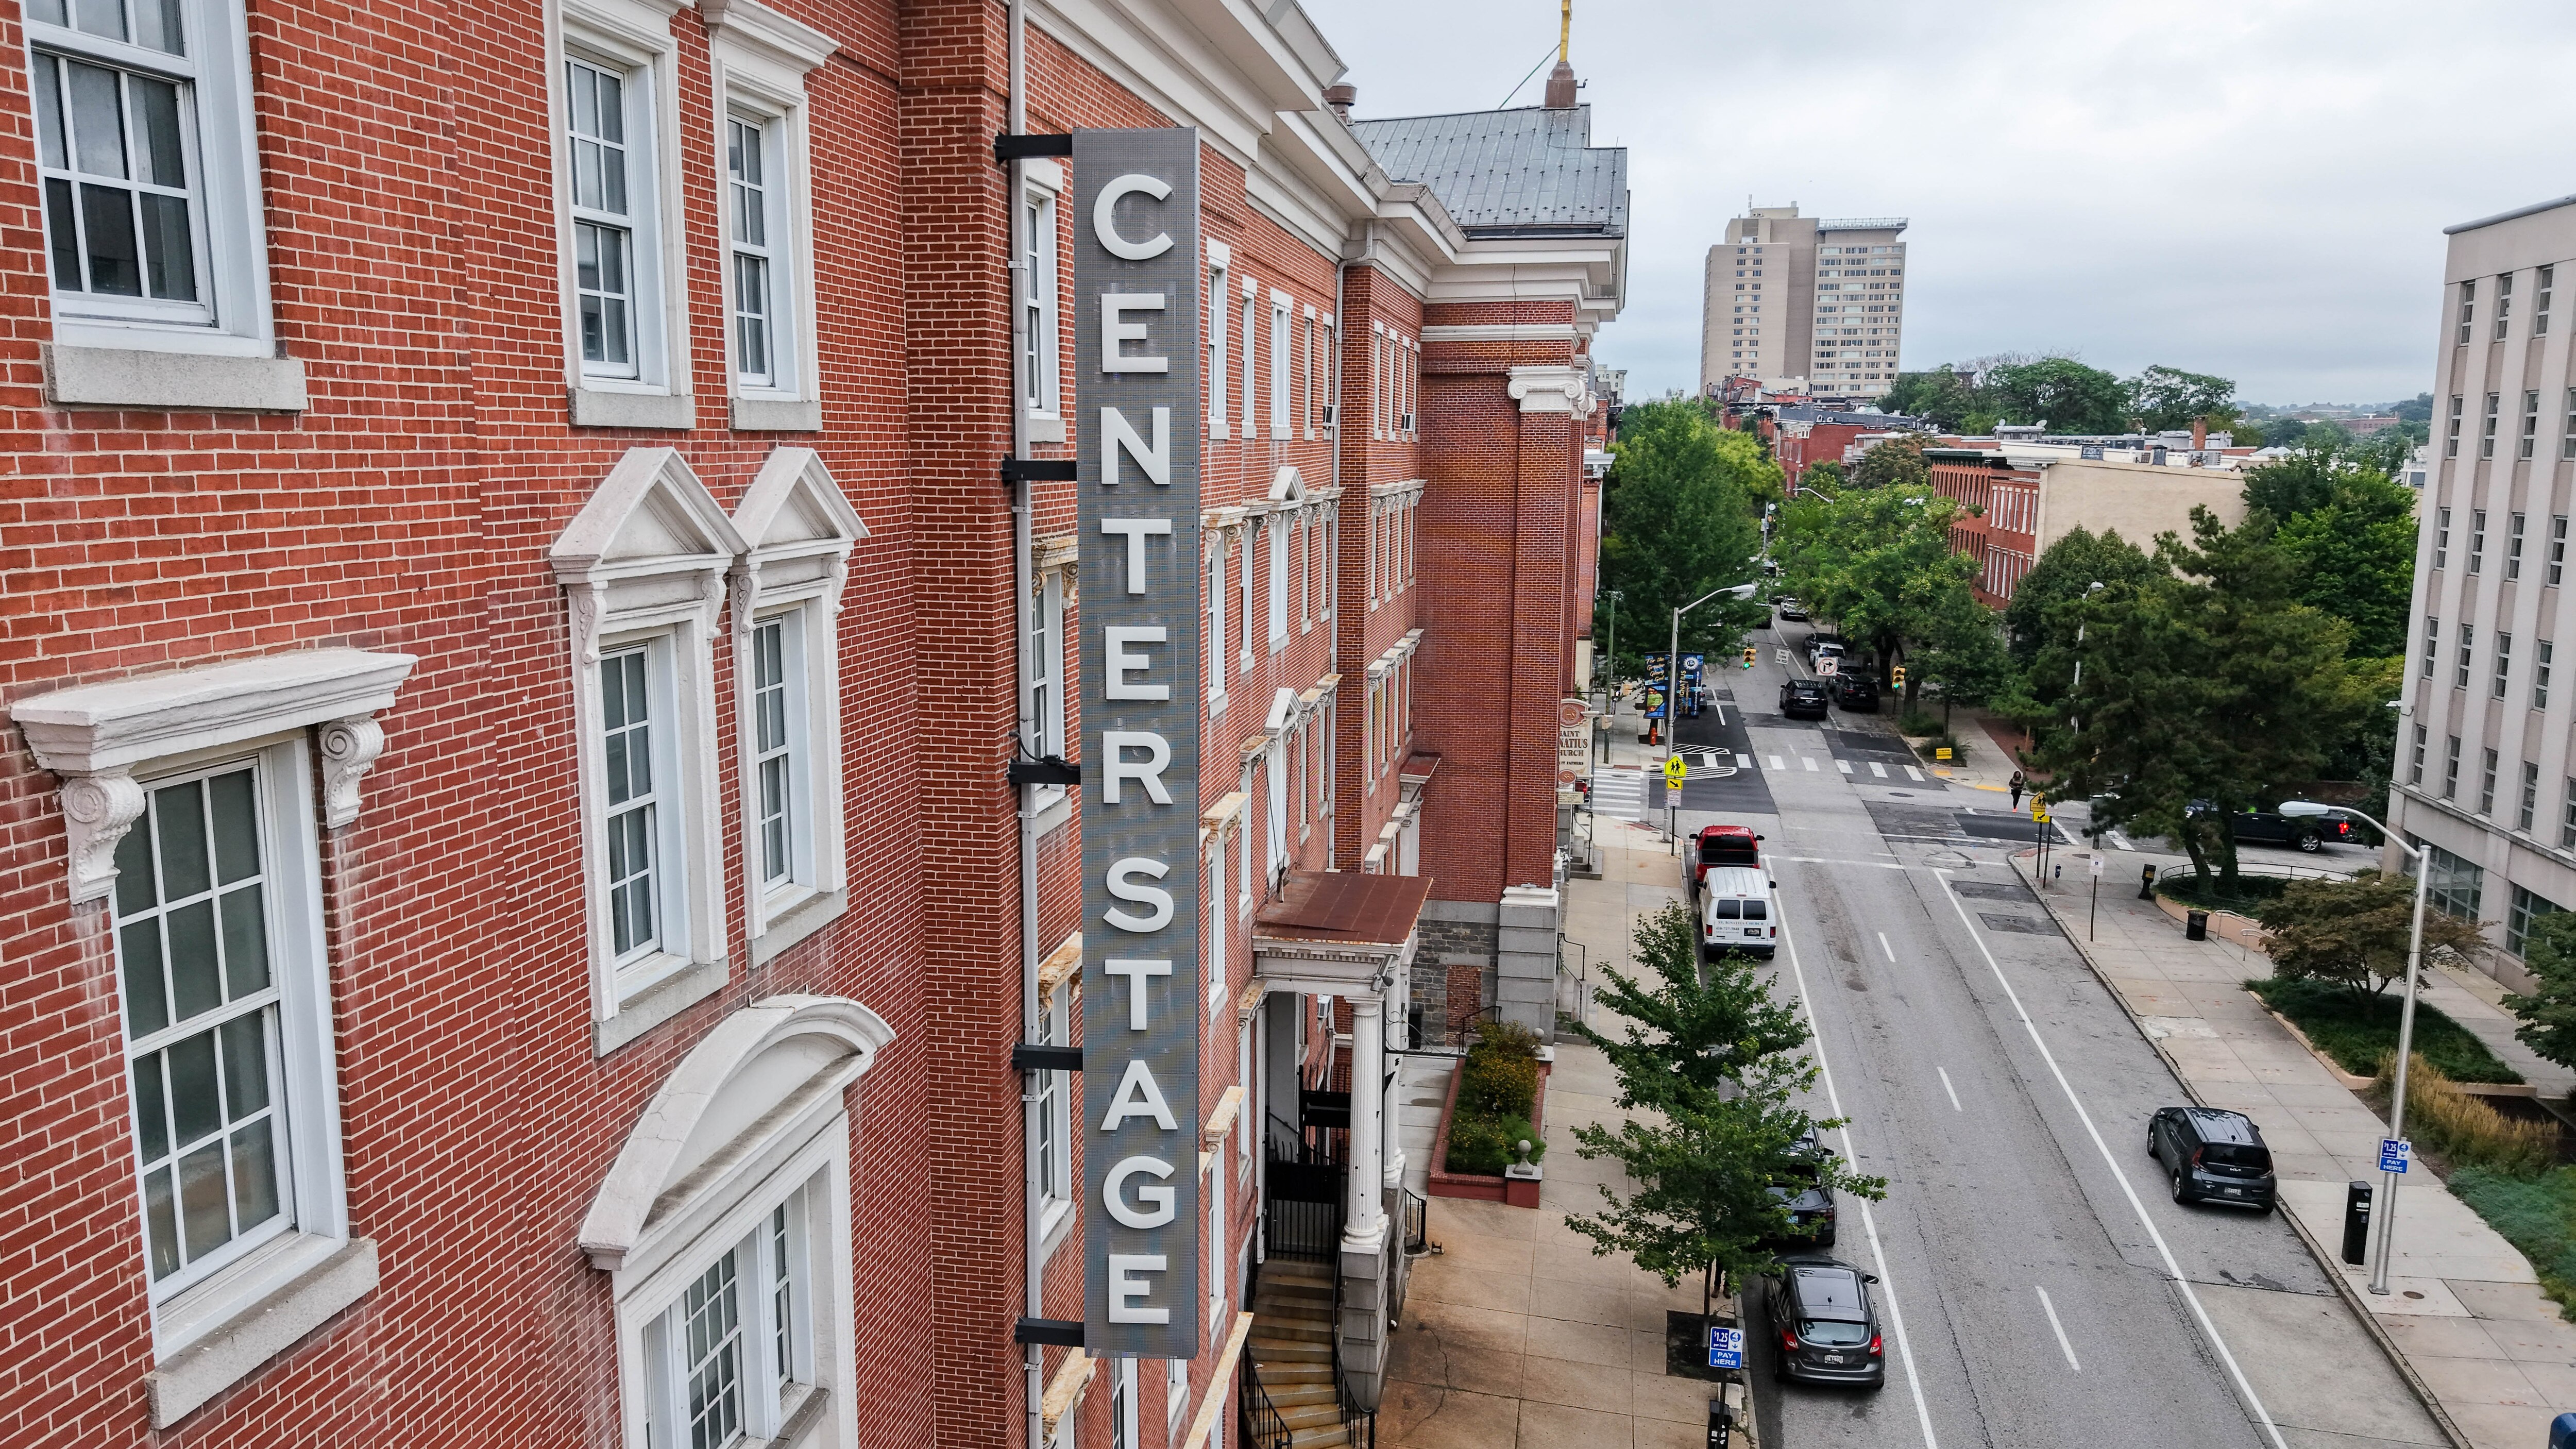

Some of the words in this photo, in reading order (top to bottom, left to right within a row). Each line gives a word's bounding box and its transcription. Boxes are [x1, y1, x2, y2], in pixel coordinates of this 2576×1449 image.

[1679, 670, 1689, 697] IGNATIUS
[1559, 738, 1588, 748] NATIUS
[1714, 1330, 1728, 1343] $1.25
